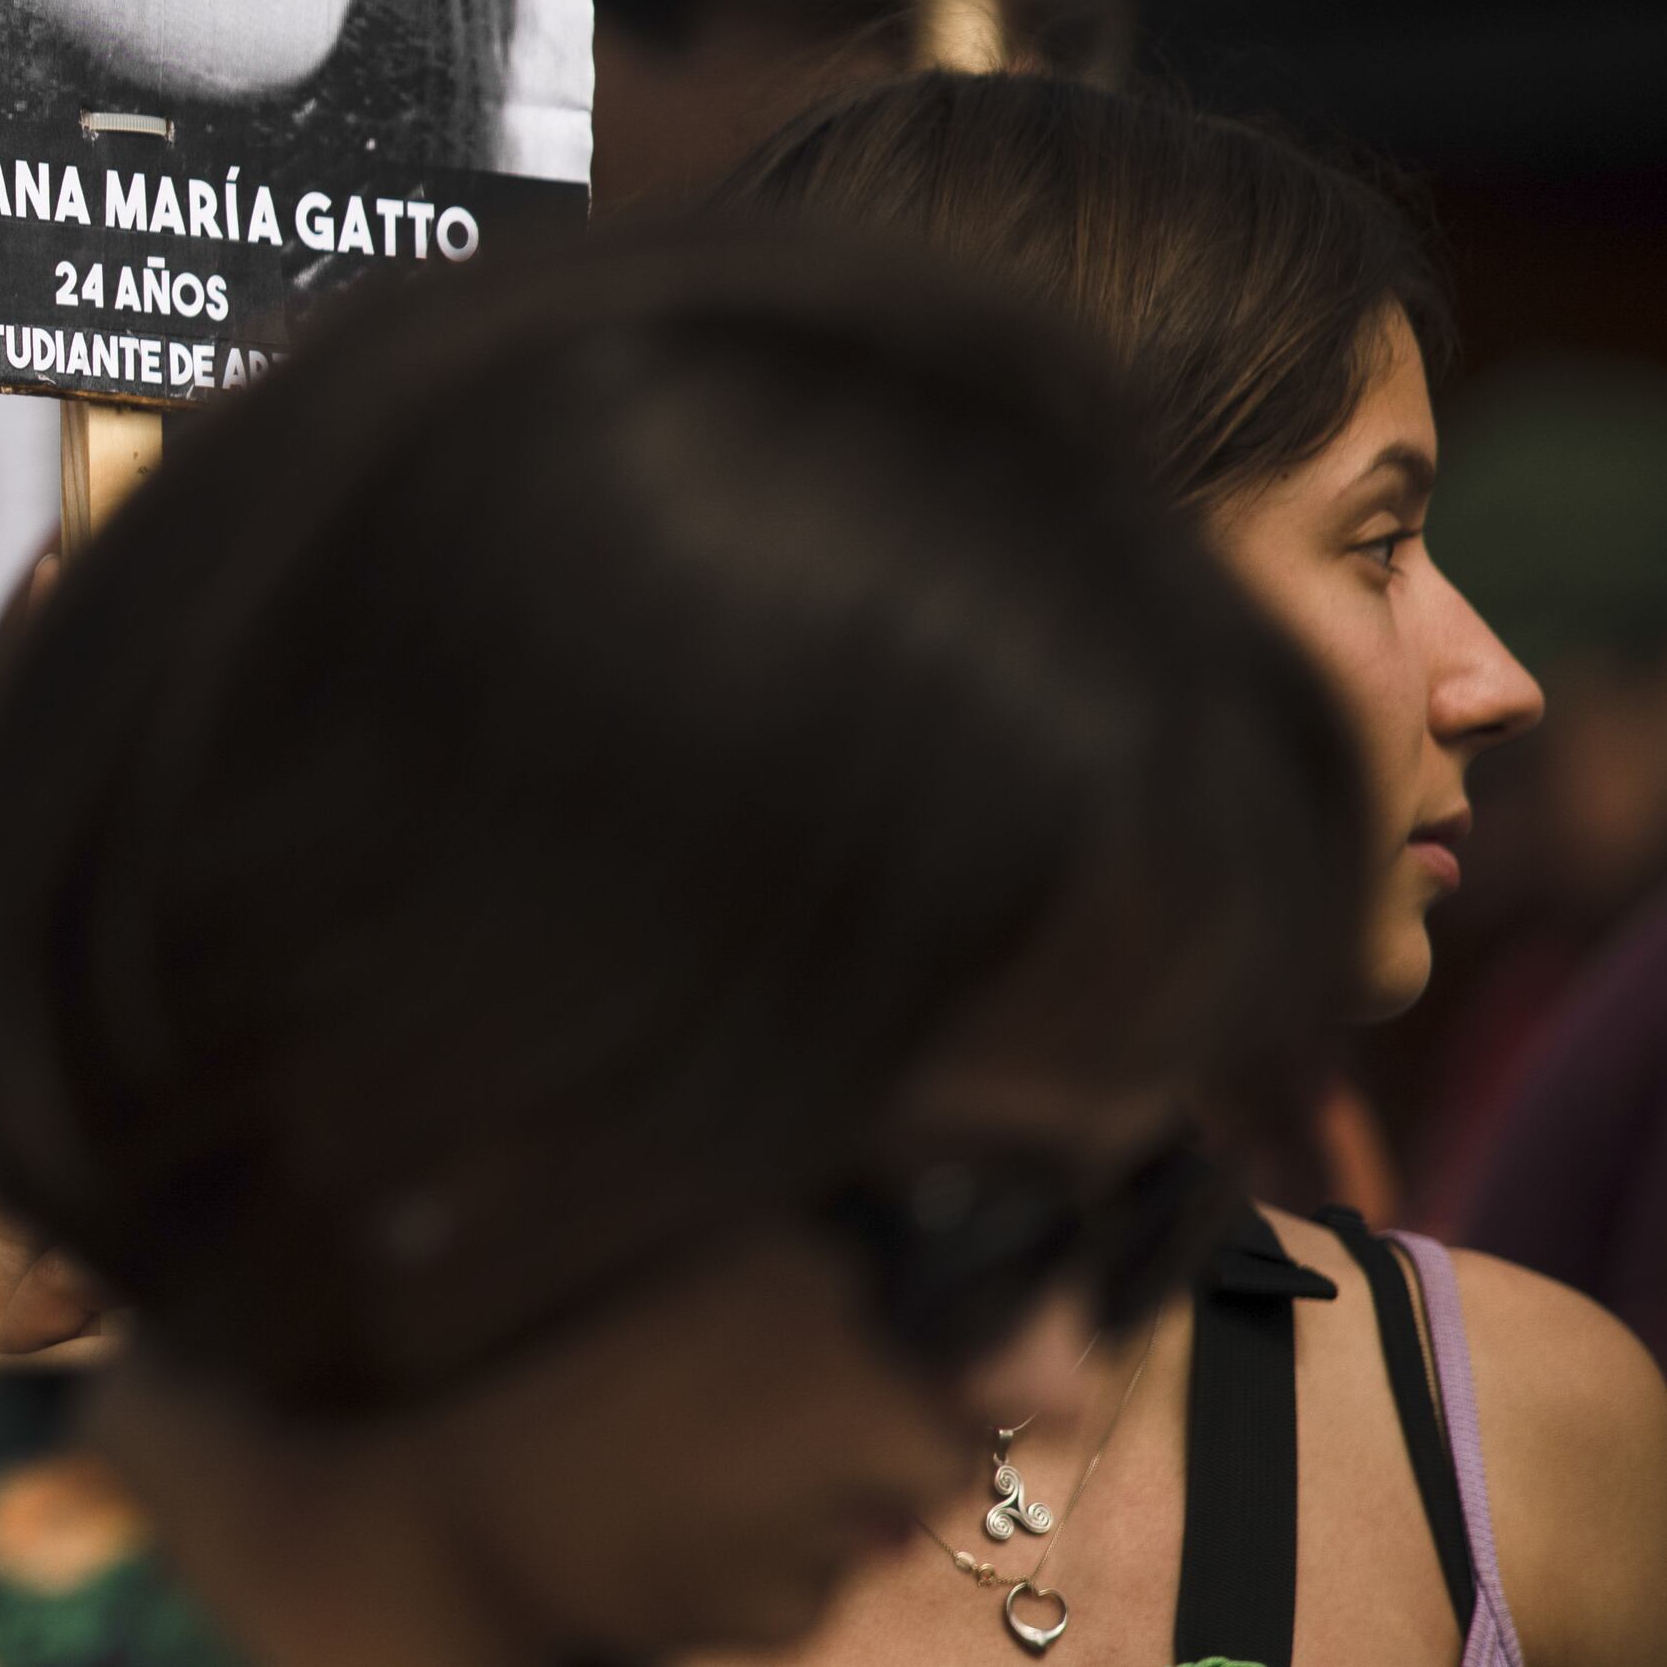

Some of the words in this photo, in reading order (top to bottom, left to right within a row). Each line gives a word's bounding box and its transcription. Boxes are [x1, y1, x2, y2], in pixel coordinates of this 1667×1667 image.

[105, 166, 283, 245] MARÍA
[295, 191, 479, 262] GATTO
[54, 261, 105, 309] 24
[114, 256, 229, 322] AÑOS
[169, 342, 216, 388] DE
